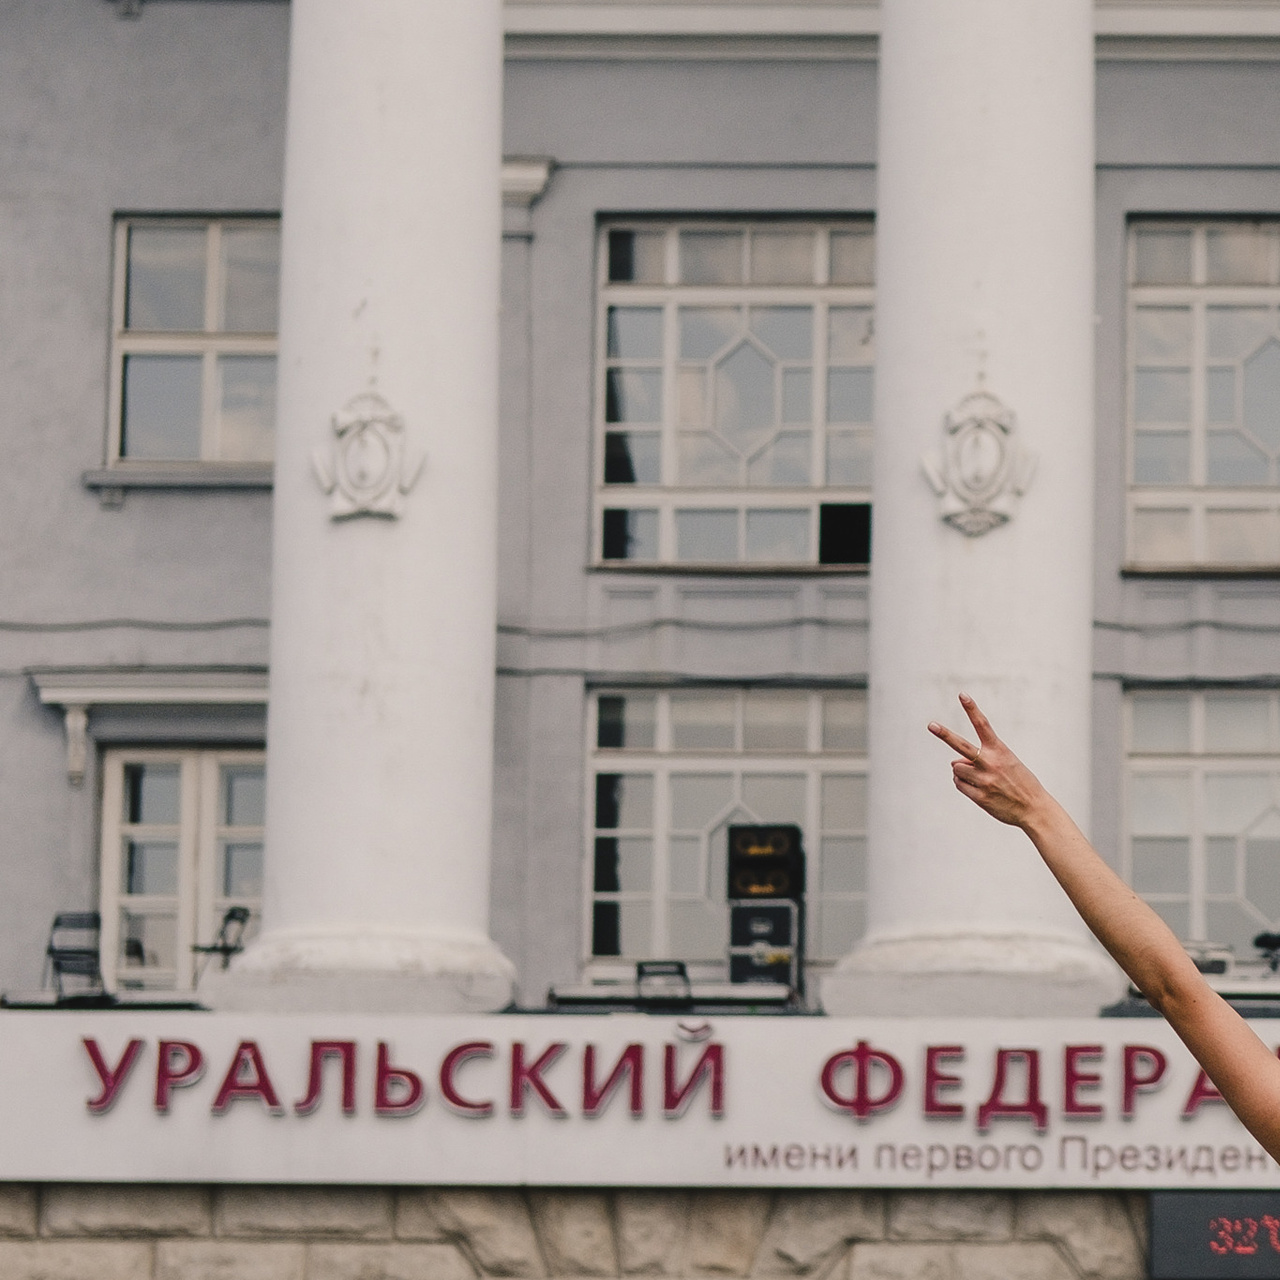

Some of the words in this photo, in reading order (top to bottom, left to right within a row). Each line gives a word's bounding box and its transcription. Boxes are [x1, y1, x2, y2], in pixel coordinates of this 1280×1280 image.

[81, 1020, 728, 1118] УРАЛЬСКИЙ
[724, 1142, 859, 1170] имени
[875, 1141, 1044, 1179] первого
[1058, 1135, 1274, 1179] Президен
